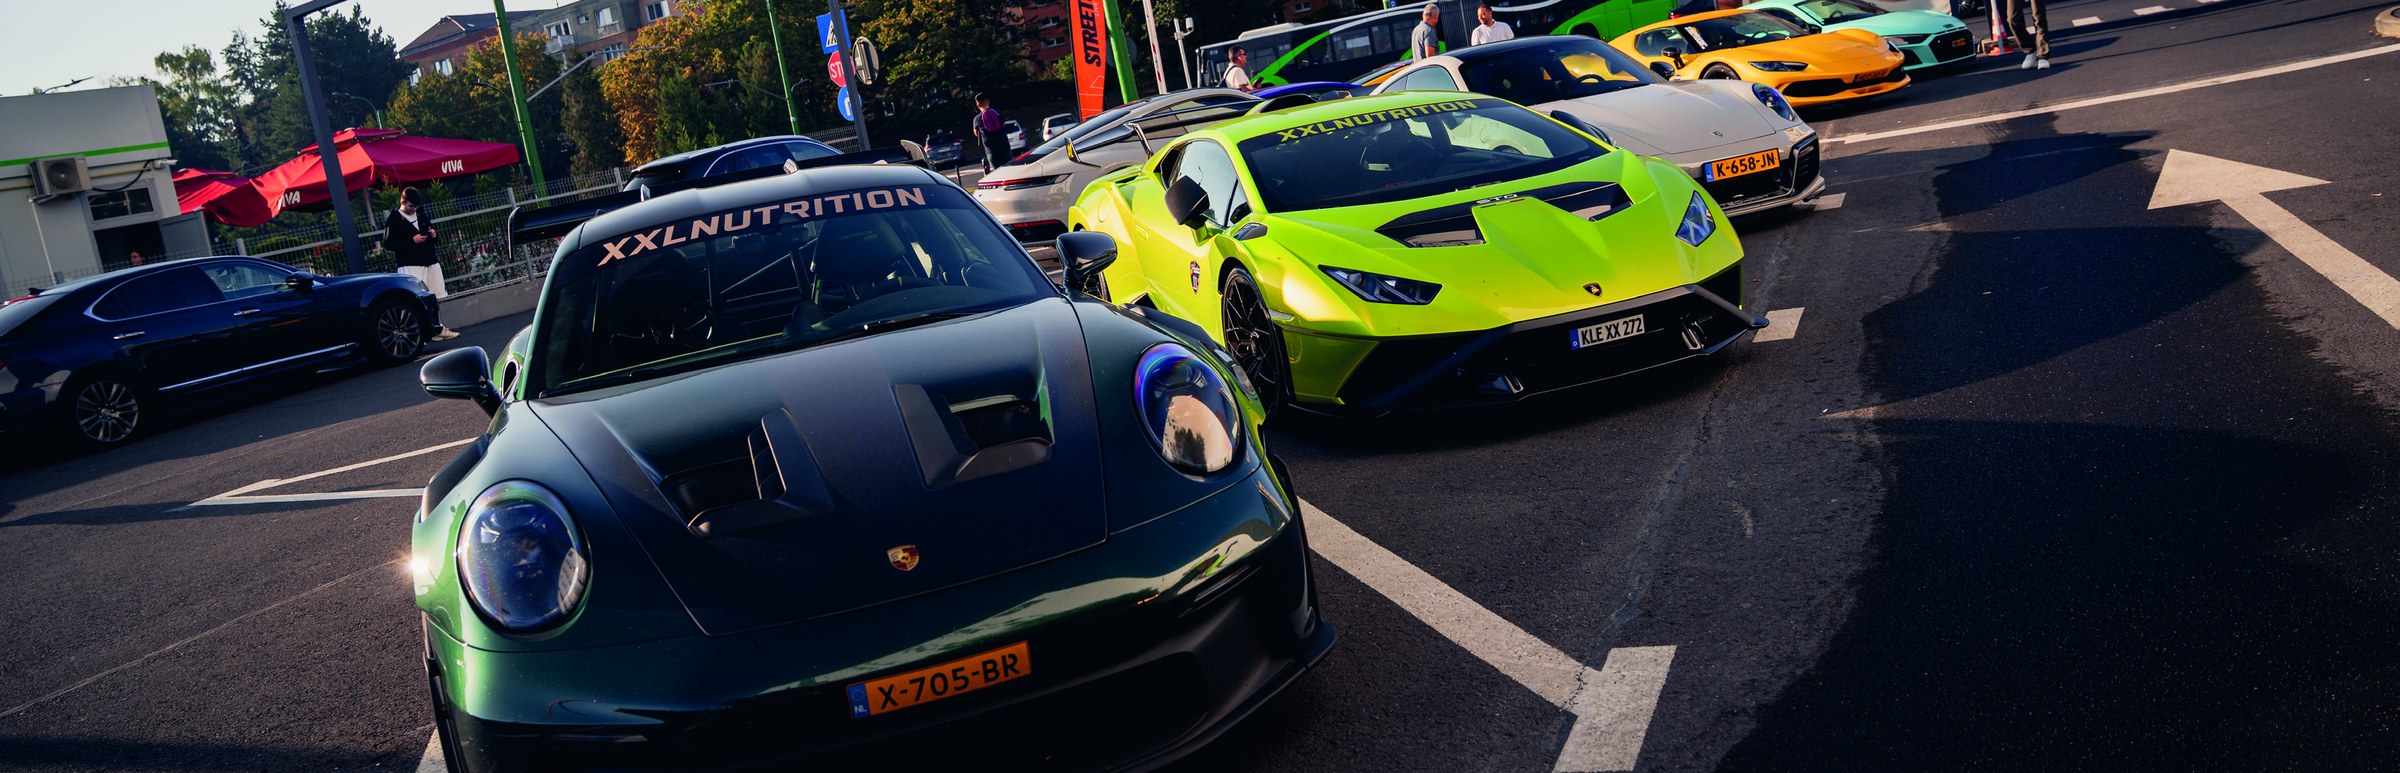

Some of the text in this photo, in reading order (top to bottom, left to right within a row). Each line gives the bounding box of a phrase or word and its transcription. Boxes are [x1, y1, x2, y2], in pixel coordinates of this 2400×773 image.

[1276, 100, 1478, 142] XXLNUTRITION
[441, 159, 464, 174] VIVA
[1716, 152, 1776, 178] K-658-JN
[597, 187, 926, 267] XXLNUTRITION
[1581, 327, 1604, 345] KLE
[1605, 322, 1621, 340] XX
[1622, 317, 1643, 336] 272
[854, 653, 1021, 714] NL X-705-BR
